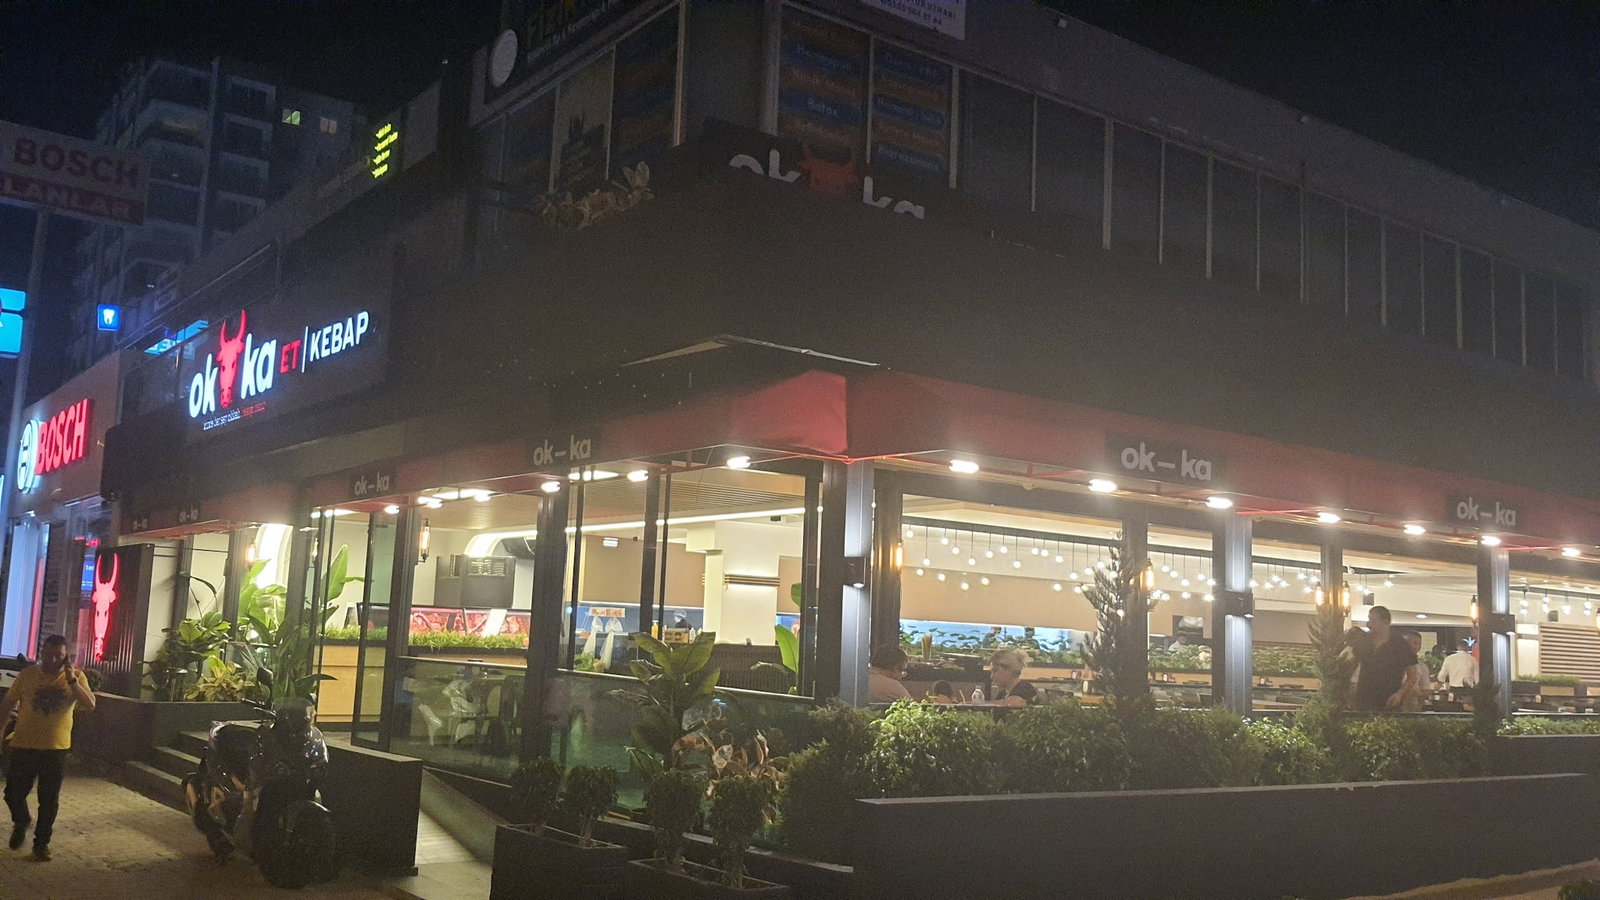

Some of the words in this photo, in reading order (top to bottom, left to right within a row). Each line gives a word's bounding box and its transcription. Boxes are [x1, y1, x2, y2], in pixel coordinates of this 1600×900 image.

[14, 136, 139, 187] BOSCH
[279, 339, 302, 374] ET
[309, 310, 370, 363] KEBAP
[34, 397, 90, 476] BOSCH
